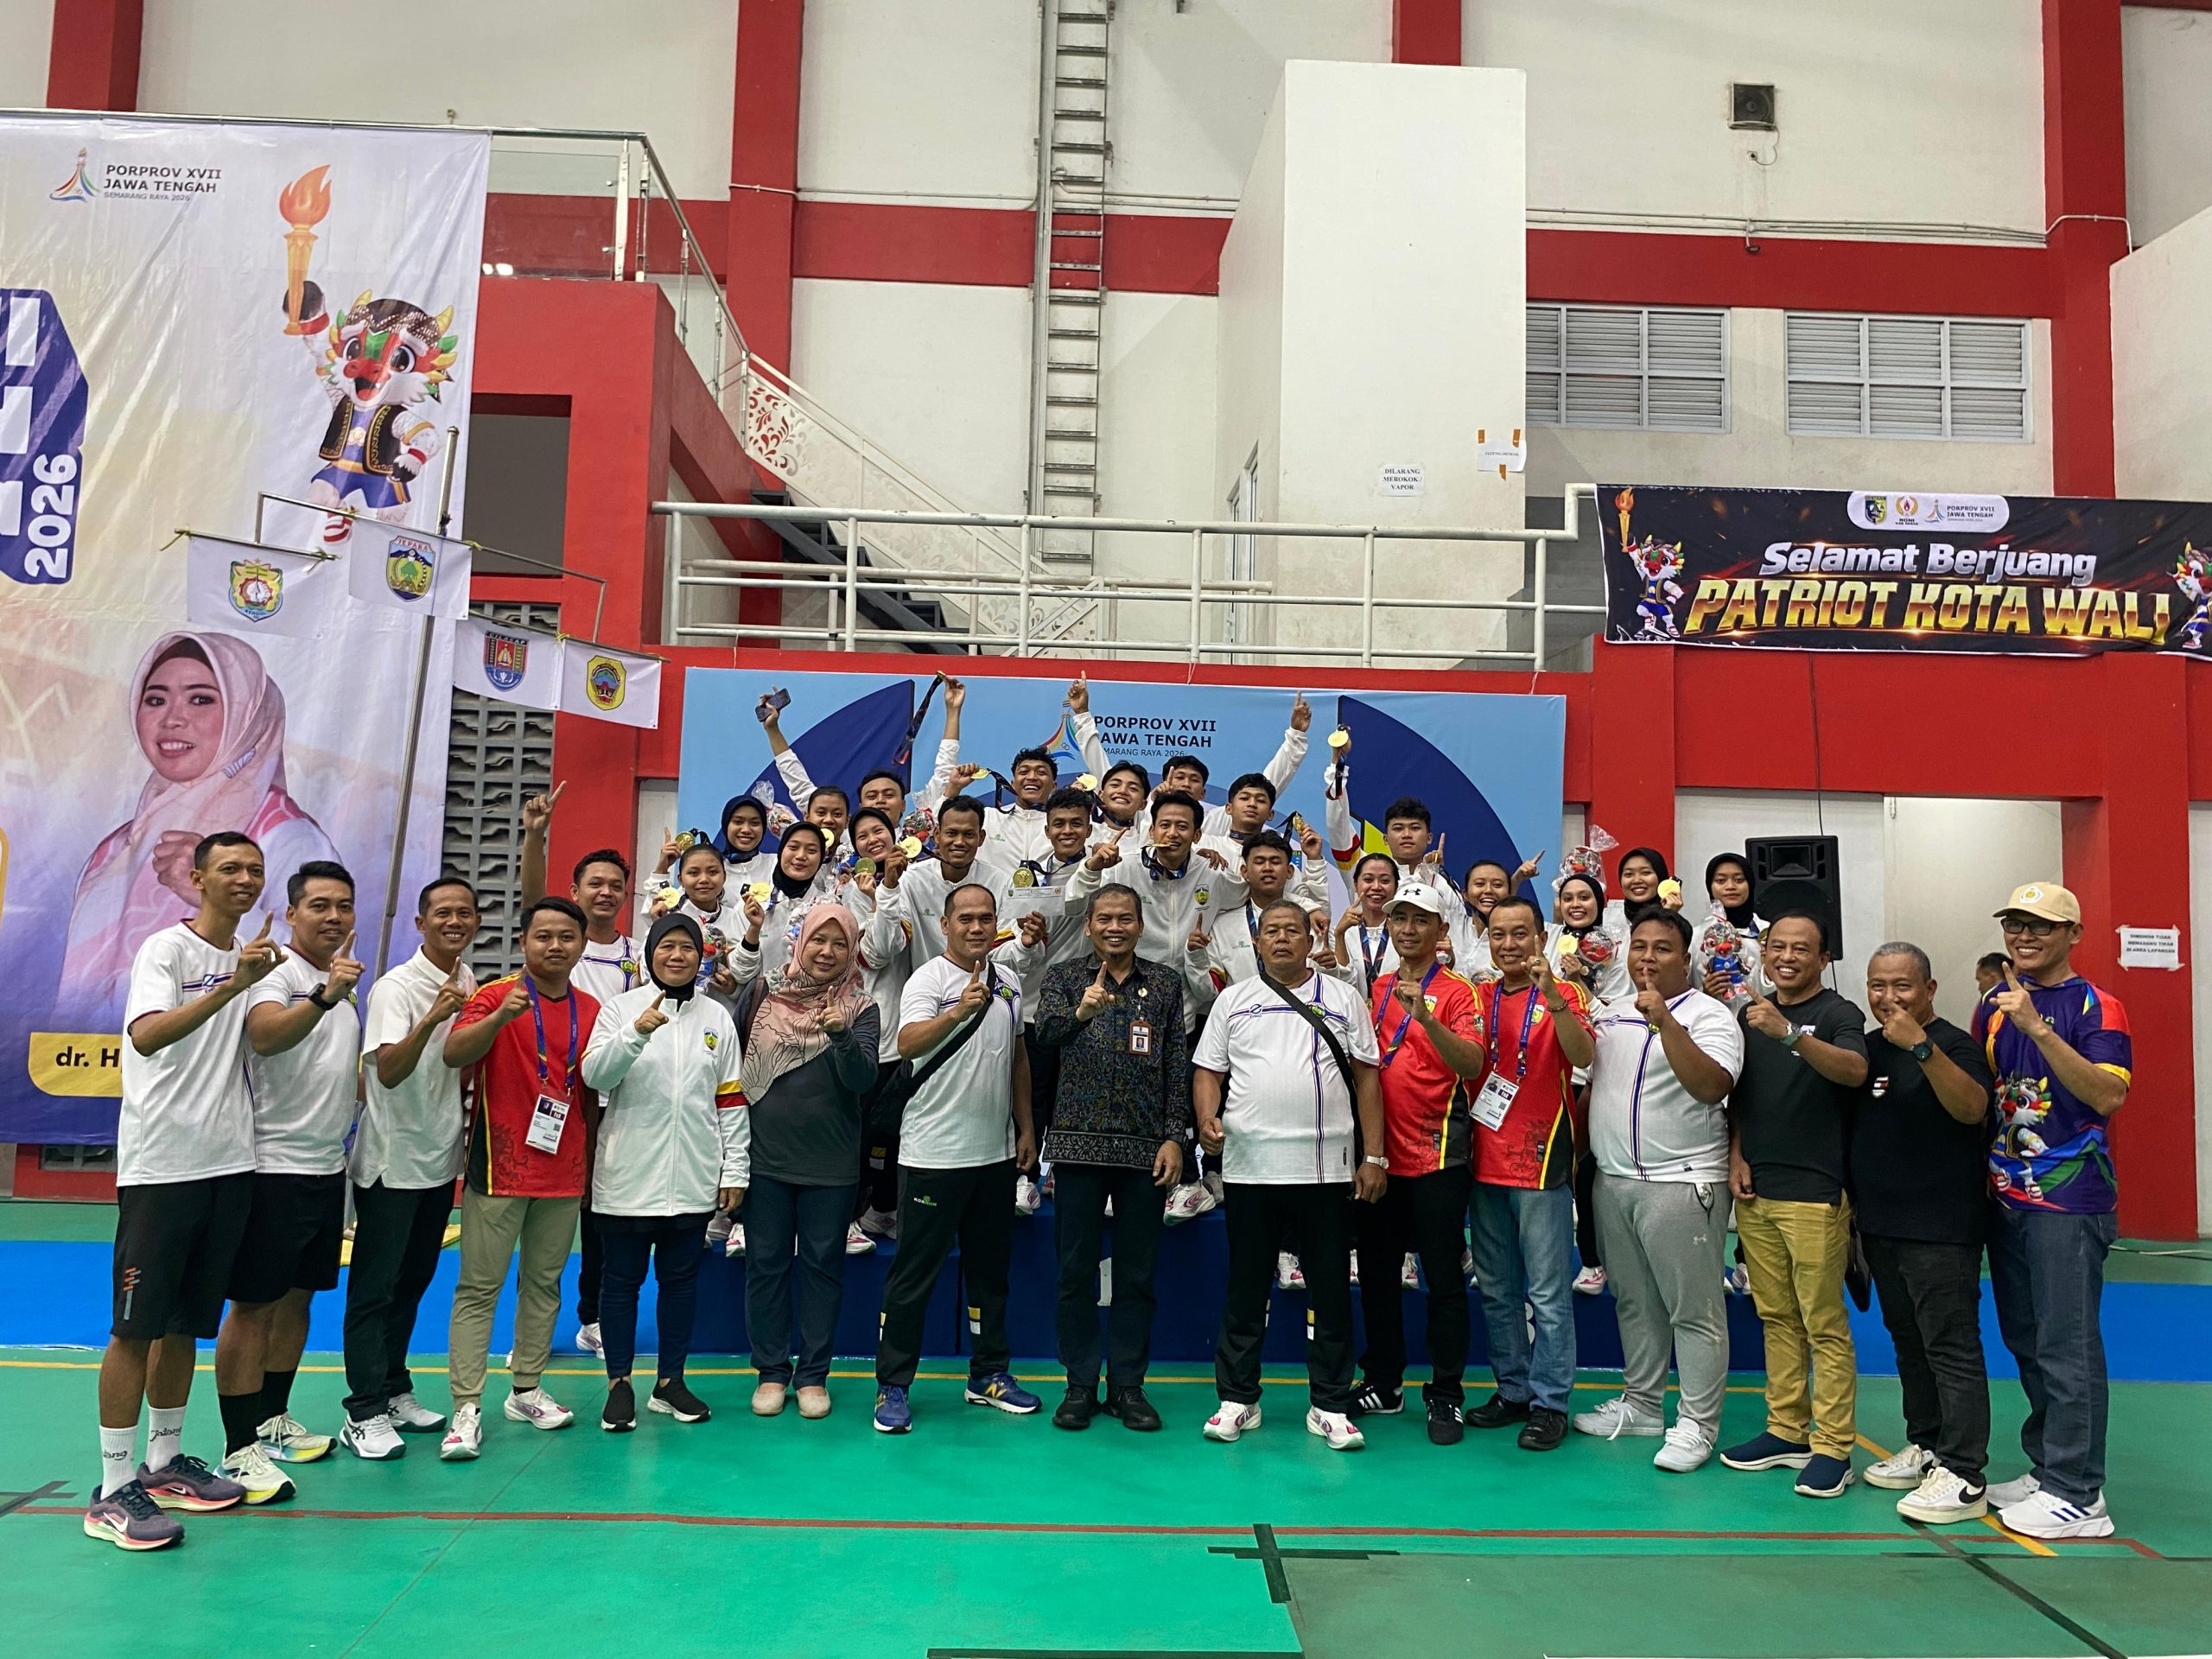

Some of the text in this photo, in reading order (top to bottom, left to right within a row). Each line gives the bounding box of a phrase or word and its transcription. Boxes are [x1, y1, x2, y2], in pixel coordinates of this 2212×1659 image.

[106, 164, 221, 180] PORPROV XVII
[104, 179, 217, 193] JAWA TENGAH
[104, 192, 148, 200] SEMARANG
[24, 454, 77, 578] 2026
[1759, 542, 2097, 587] Selamat Berjuang
[1684, 579, 2171, 645] PATRIOT KOTA WALI
[489, 633, 528, 645] CILACAP
[1095, 716, 1217, 732] PORPROV XVII
[1100, 734, 1211, 747] AWA TENGAH
[56, 1046, 121, 1068] dr. H
